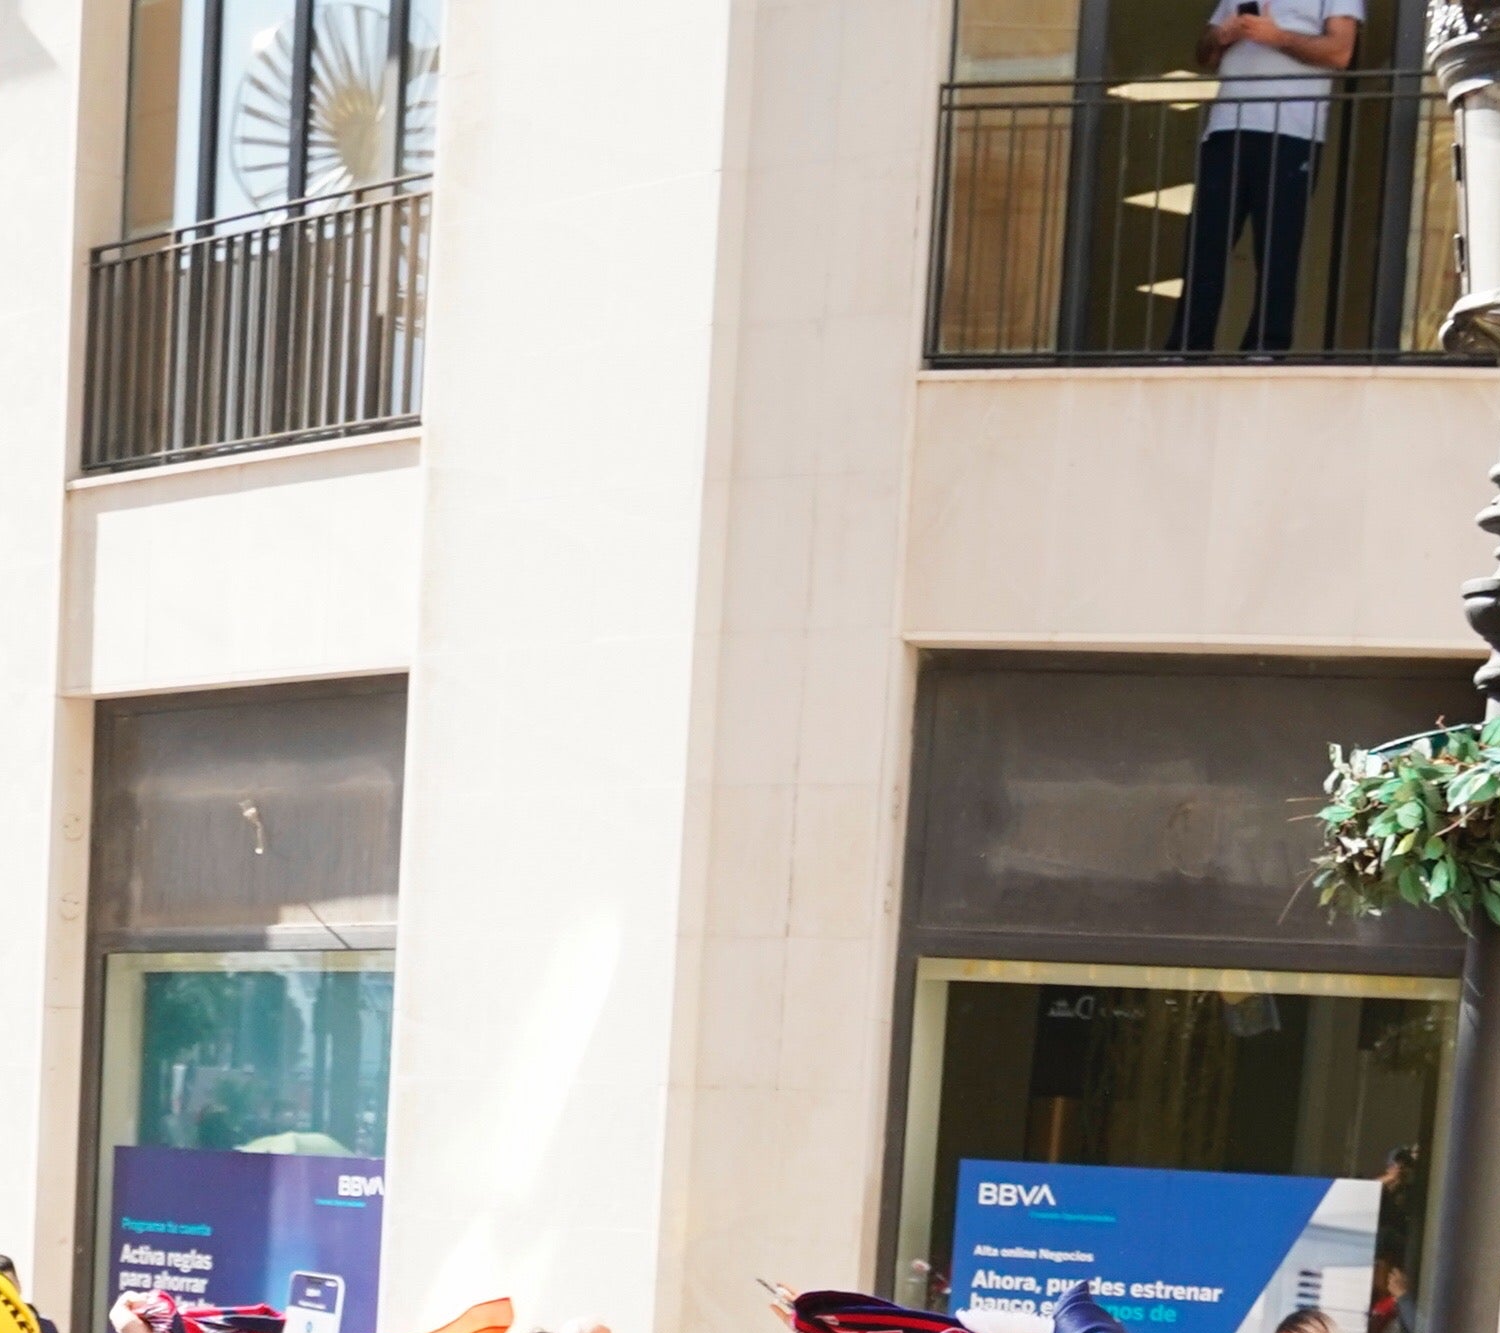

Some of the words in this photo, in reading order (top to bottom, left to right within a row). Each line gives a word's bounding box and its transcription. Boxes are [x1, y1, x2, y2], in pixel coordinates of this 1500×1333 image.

[977, 1183, 1056, 1206] BBVA
[119, 1243, 165, 1266] Activa
[167, 1248, 213, 1273] reglas
[973, 1244, 998, 1258] Alta
[1000, 1246, 1037, 1260] online
[1038, 1248, 1094, 1263] Negocios
[119, 1270, 151, 1292] para
[152, 1272, 209, 1294] ahorrar
[971, 1269, 1042, 1294] Ahora,
[1130, 1280, 1223, 1303] estrenar
[969, 1293, 1034, 1316] banco
[1150, 1304, 1177, 1323] de
